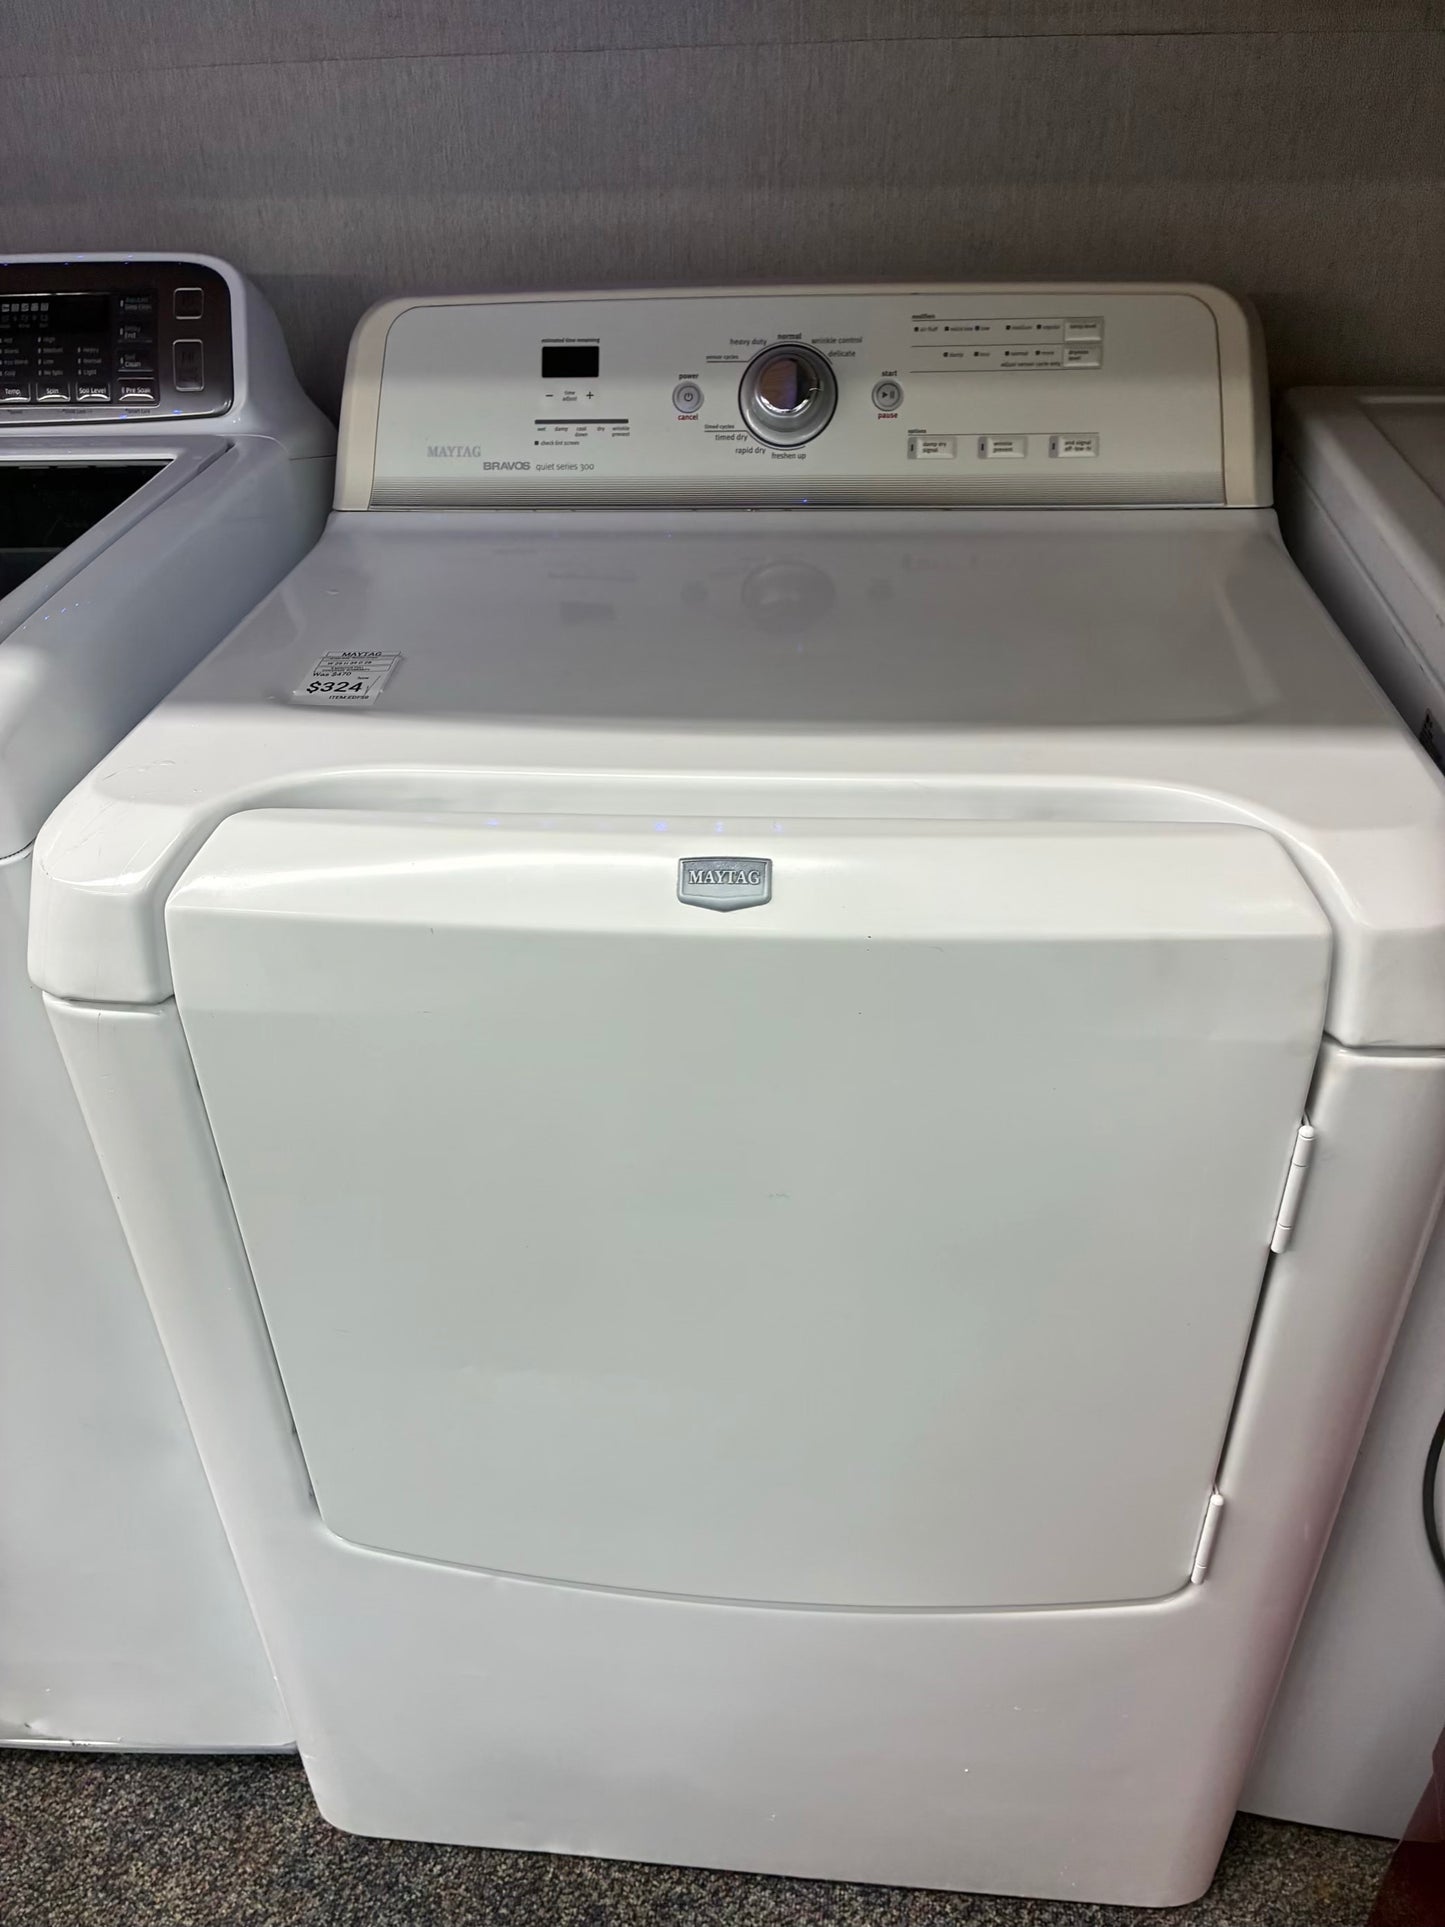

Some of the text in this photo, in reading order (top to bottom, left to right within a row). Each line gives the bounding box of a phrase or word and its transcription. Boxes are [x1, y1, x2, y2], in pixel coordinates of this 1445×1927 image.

[777, 332, 802, 340] normal
[838, 336, 863, 344] control
[729, 338, 767, 347] heavy duty
[828, 349, 856, 357] delicate
[137, 386, 151, 394] Soak
[677, 413, 699, 421] cancel
[877, 412, 898, 420] pause
[715, 433, 748, 442] timed dry
[427, 446, 482, 458] MAYTAG
[735, 446, 766, 455] rapid dry
[771, 452, 806, 461] freshen up
[483, 461, 595, 472] BRAVOS quiet series 300
[306, 680, 363, 694] $324
[688, 869, 761, 885] MAYTAG
